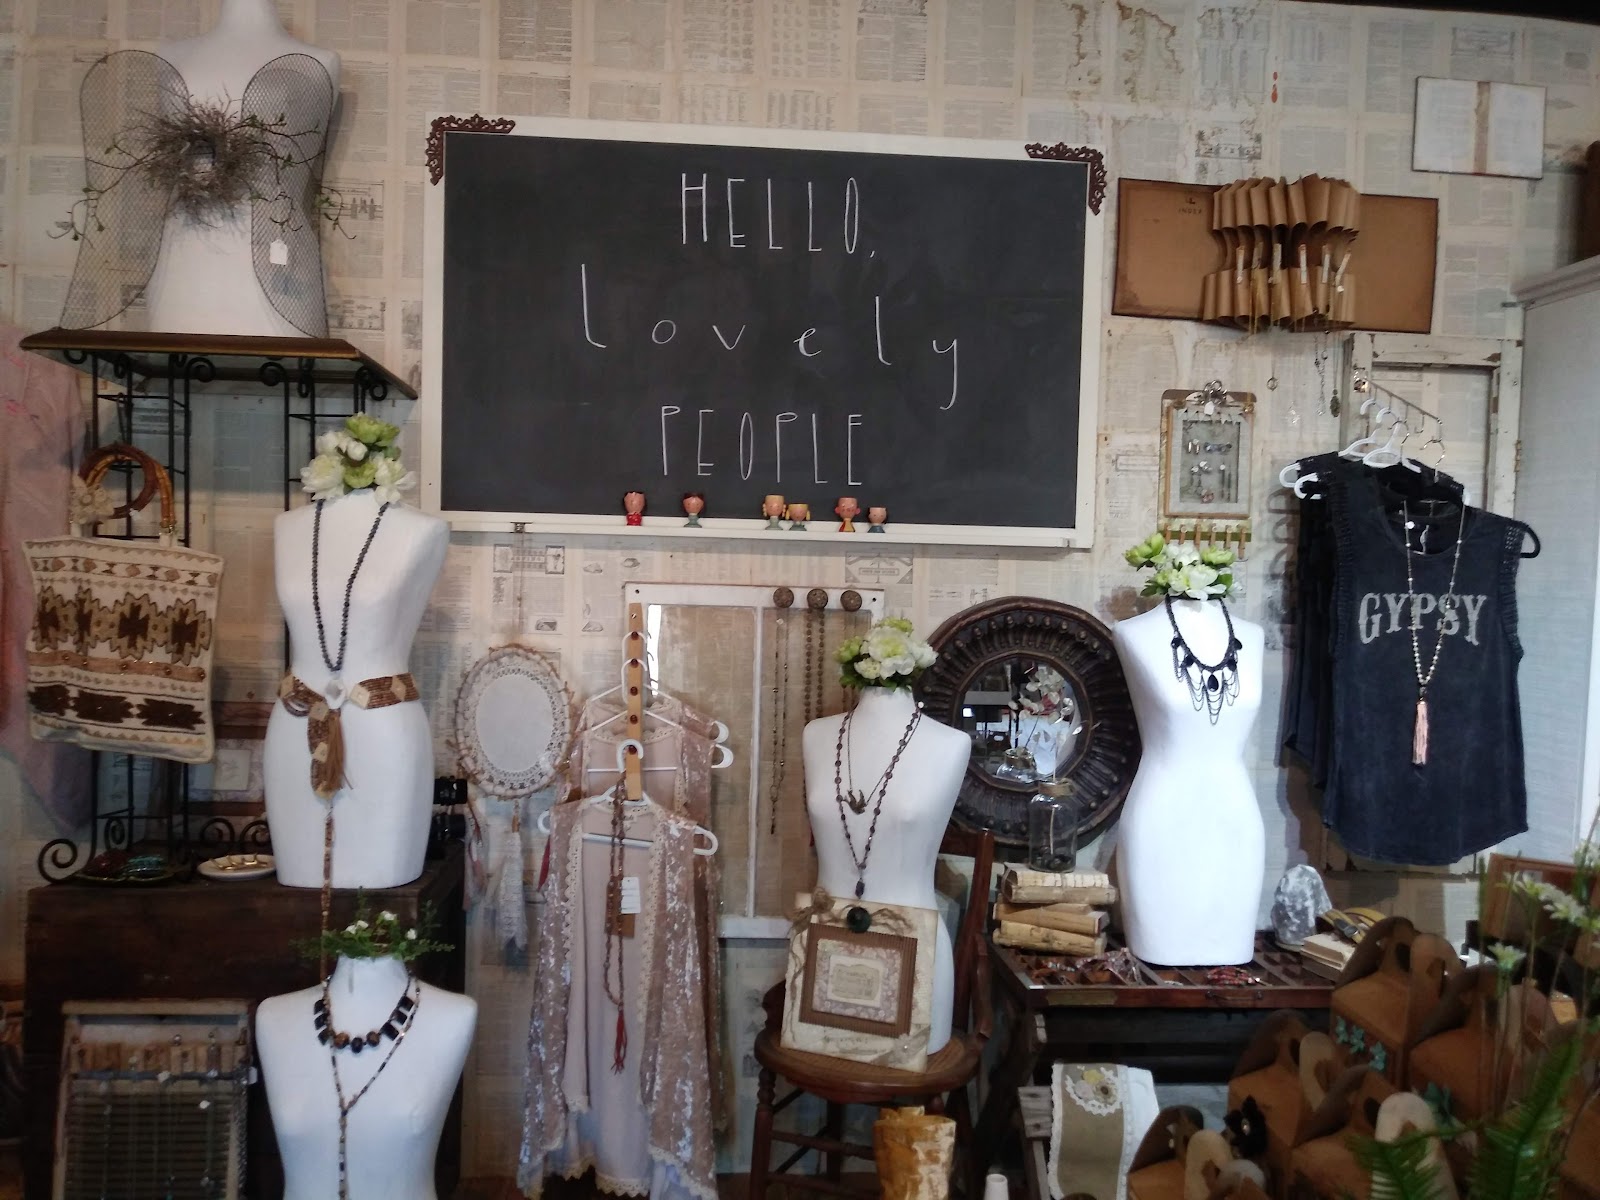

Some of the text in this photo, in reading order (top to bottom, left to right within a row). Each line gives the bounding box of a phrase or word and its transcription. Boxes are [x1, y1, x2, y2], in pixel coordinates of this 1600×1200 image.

[681, 172, 876, 258] HELLO,
[581, 263, 958, 410] lovely
[661, 405, 863, 486] PEOPLE
[1358, 592, 1488, 646] GYPSY
